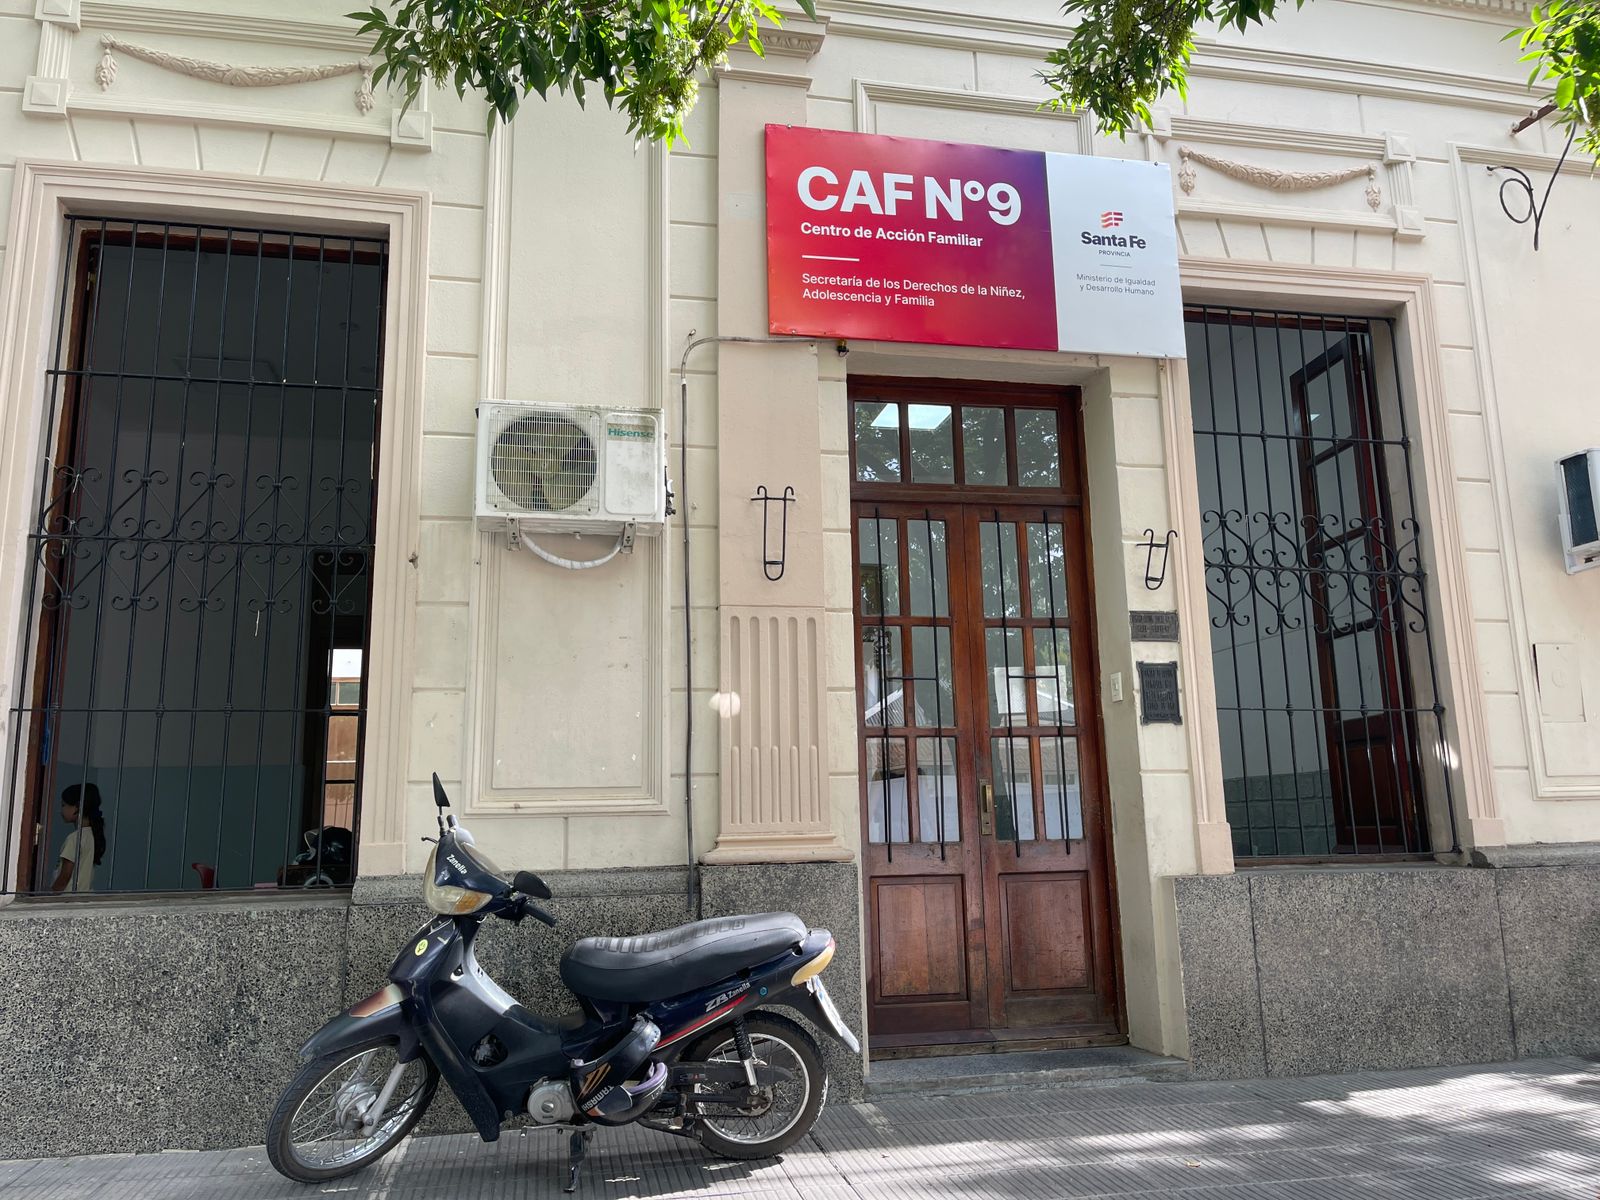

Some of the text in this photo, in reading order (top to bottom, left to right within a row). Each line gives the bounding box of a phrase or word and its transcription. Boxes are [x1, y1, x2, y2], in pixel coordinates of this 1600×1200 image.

[797, 166, 914, 215] CAF
[801, 222, 983, 247] Centro de Acción Familiar
[1081, 231, 1146, 249] Santa Fe
[1098, 249, 1131, 257] PROVINCIA
[802, 273, 1026, 299] Secretaría de los Derechos de la Niñez,
[1076, 273, 1156, 287] Ministerio de Igualdad
[802, 288, 935, 307] Adolescencia y Familia
[1079, 283, 1155, 296] y Desarrollo Humano
[608, 428, 654, 438] Hisense
[446, 854, 468, 875] Zanella
[727, 981, 751, 999] Zanella
